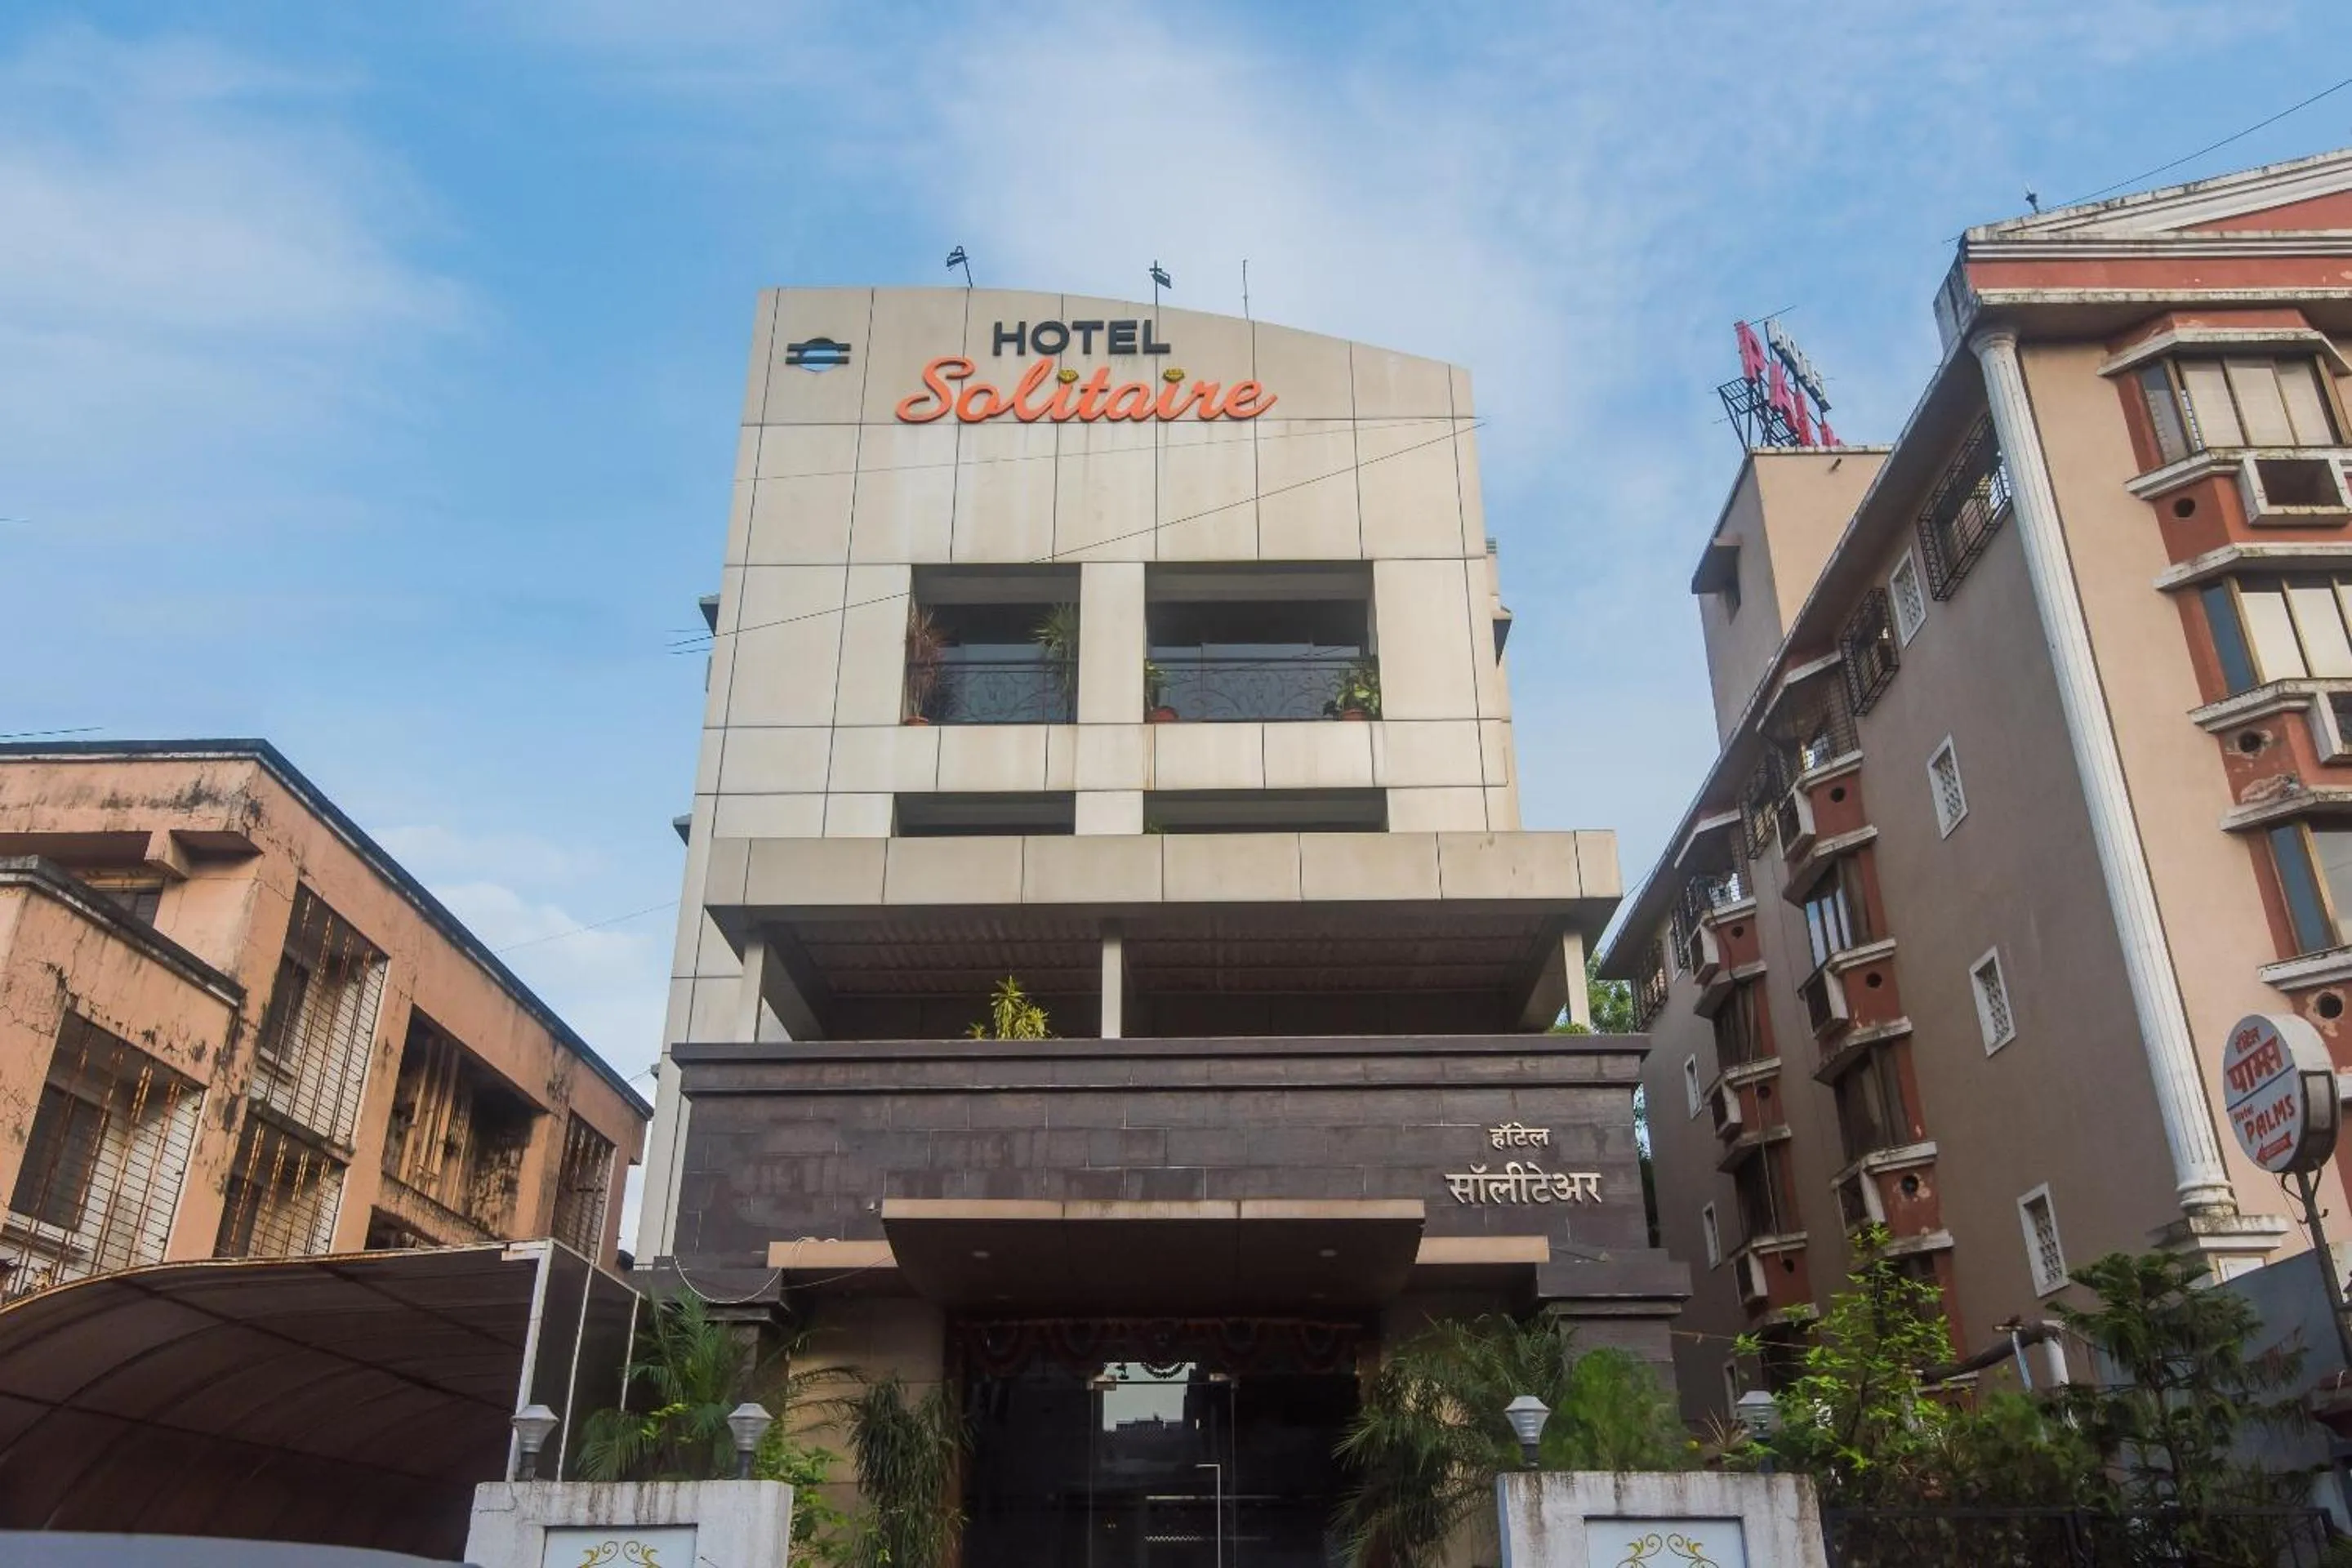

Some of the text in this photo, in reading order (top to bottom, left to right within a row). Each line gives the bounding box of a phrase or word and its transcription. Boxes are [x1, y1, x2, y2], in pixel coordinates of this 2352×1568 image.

[992, 319, 1171, 356] HOTEL
[895, 356, 1277, 424] Solitaire
[1489, 1121, 1551, 1150] हॉटेल
[2244, 1094, 2296, 1144] PALMS
[1444, 1161, 1602, 1204] सॉलीटेअर
